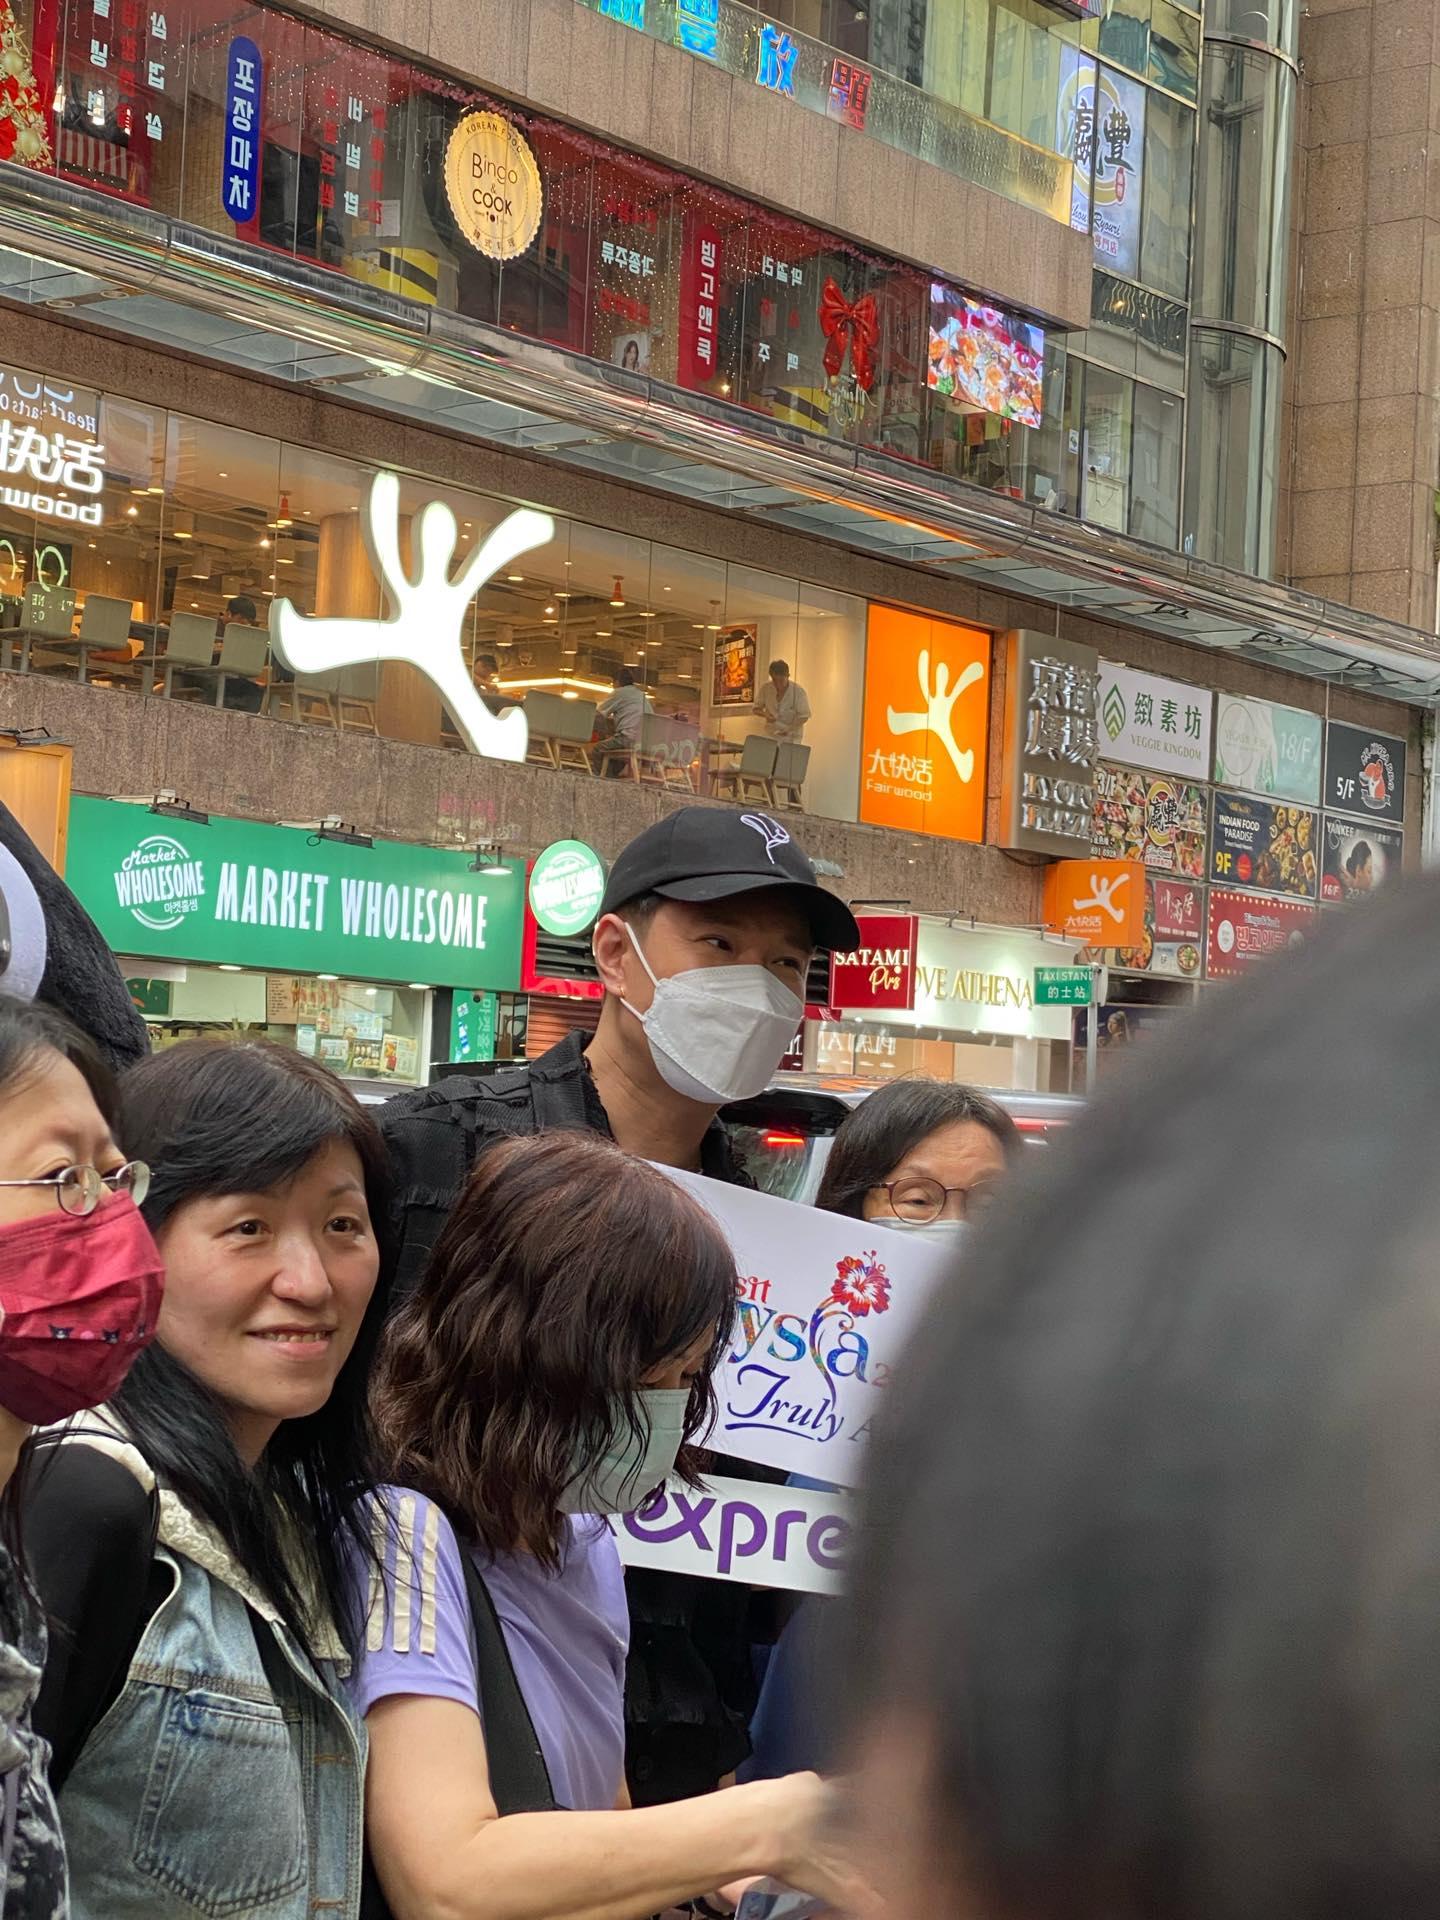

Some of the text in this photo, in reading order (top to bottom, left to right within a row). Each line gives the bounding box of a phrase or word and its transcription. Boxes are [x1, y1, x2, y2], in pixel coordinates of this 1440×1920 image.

[228, 57, 256, 211] 포장마차
[466, 121, 498, 135] KOREAN
[472, 153, 518, 185] Bingo
[472, 189, 513, 217] COOK
[0, 484, 104, 526] wood
[1131, 733, 1161, 752] VEGGIE
[1163, 741, 1202, 761] KINGDOM
[1280, 732, 1313, 764] 18/F
[867, 748, 934, 786] 大快活
[865, 778, 932, 802] Fairwood
[1097, 773, 1117, 797] 3/F
[1336, 776, 1356, 800] 5/F
[1218, 814, 1261, 832] INDIAN FOOD
[1224, 827, 1254, 843] PARADISE
[121, 847, 177, 871] Market
[1215, 851, 1232, 875] 9F
[113, 860, 205, 908] WHOLESOME
[214, 862, 329, 933] MARKET
[340, 877, 488, 950] WHOLESOME
[835, 949, 909, 966] SATAMI
[1037, 971, 1059, 982] TAXI
[950, 969, 1034, 1011] ATHENA
[1047, 985, 1086, 999] 的士站
[727, 1363, 844, 1442] Truly
